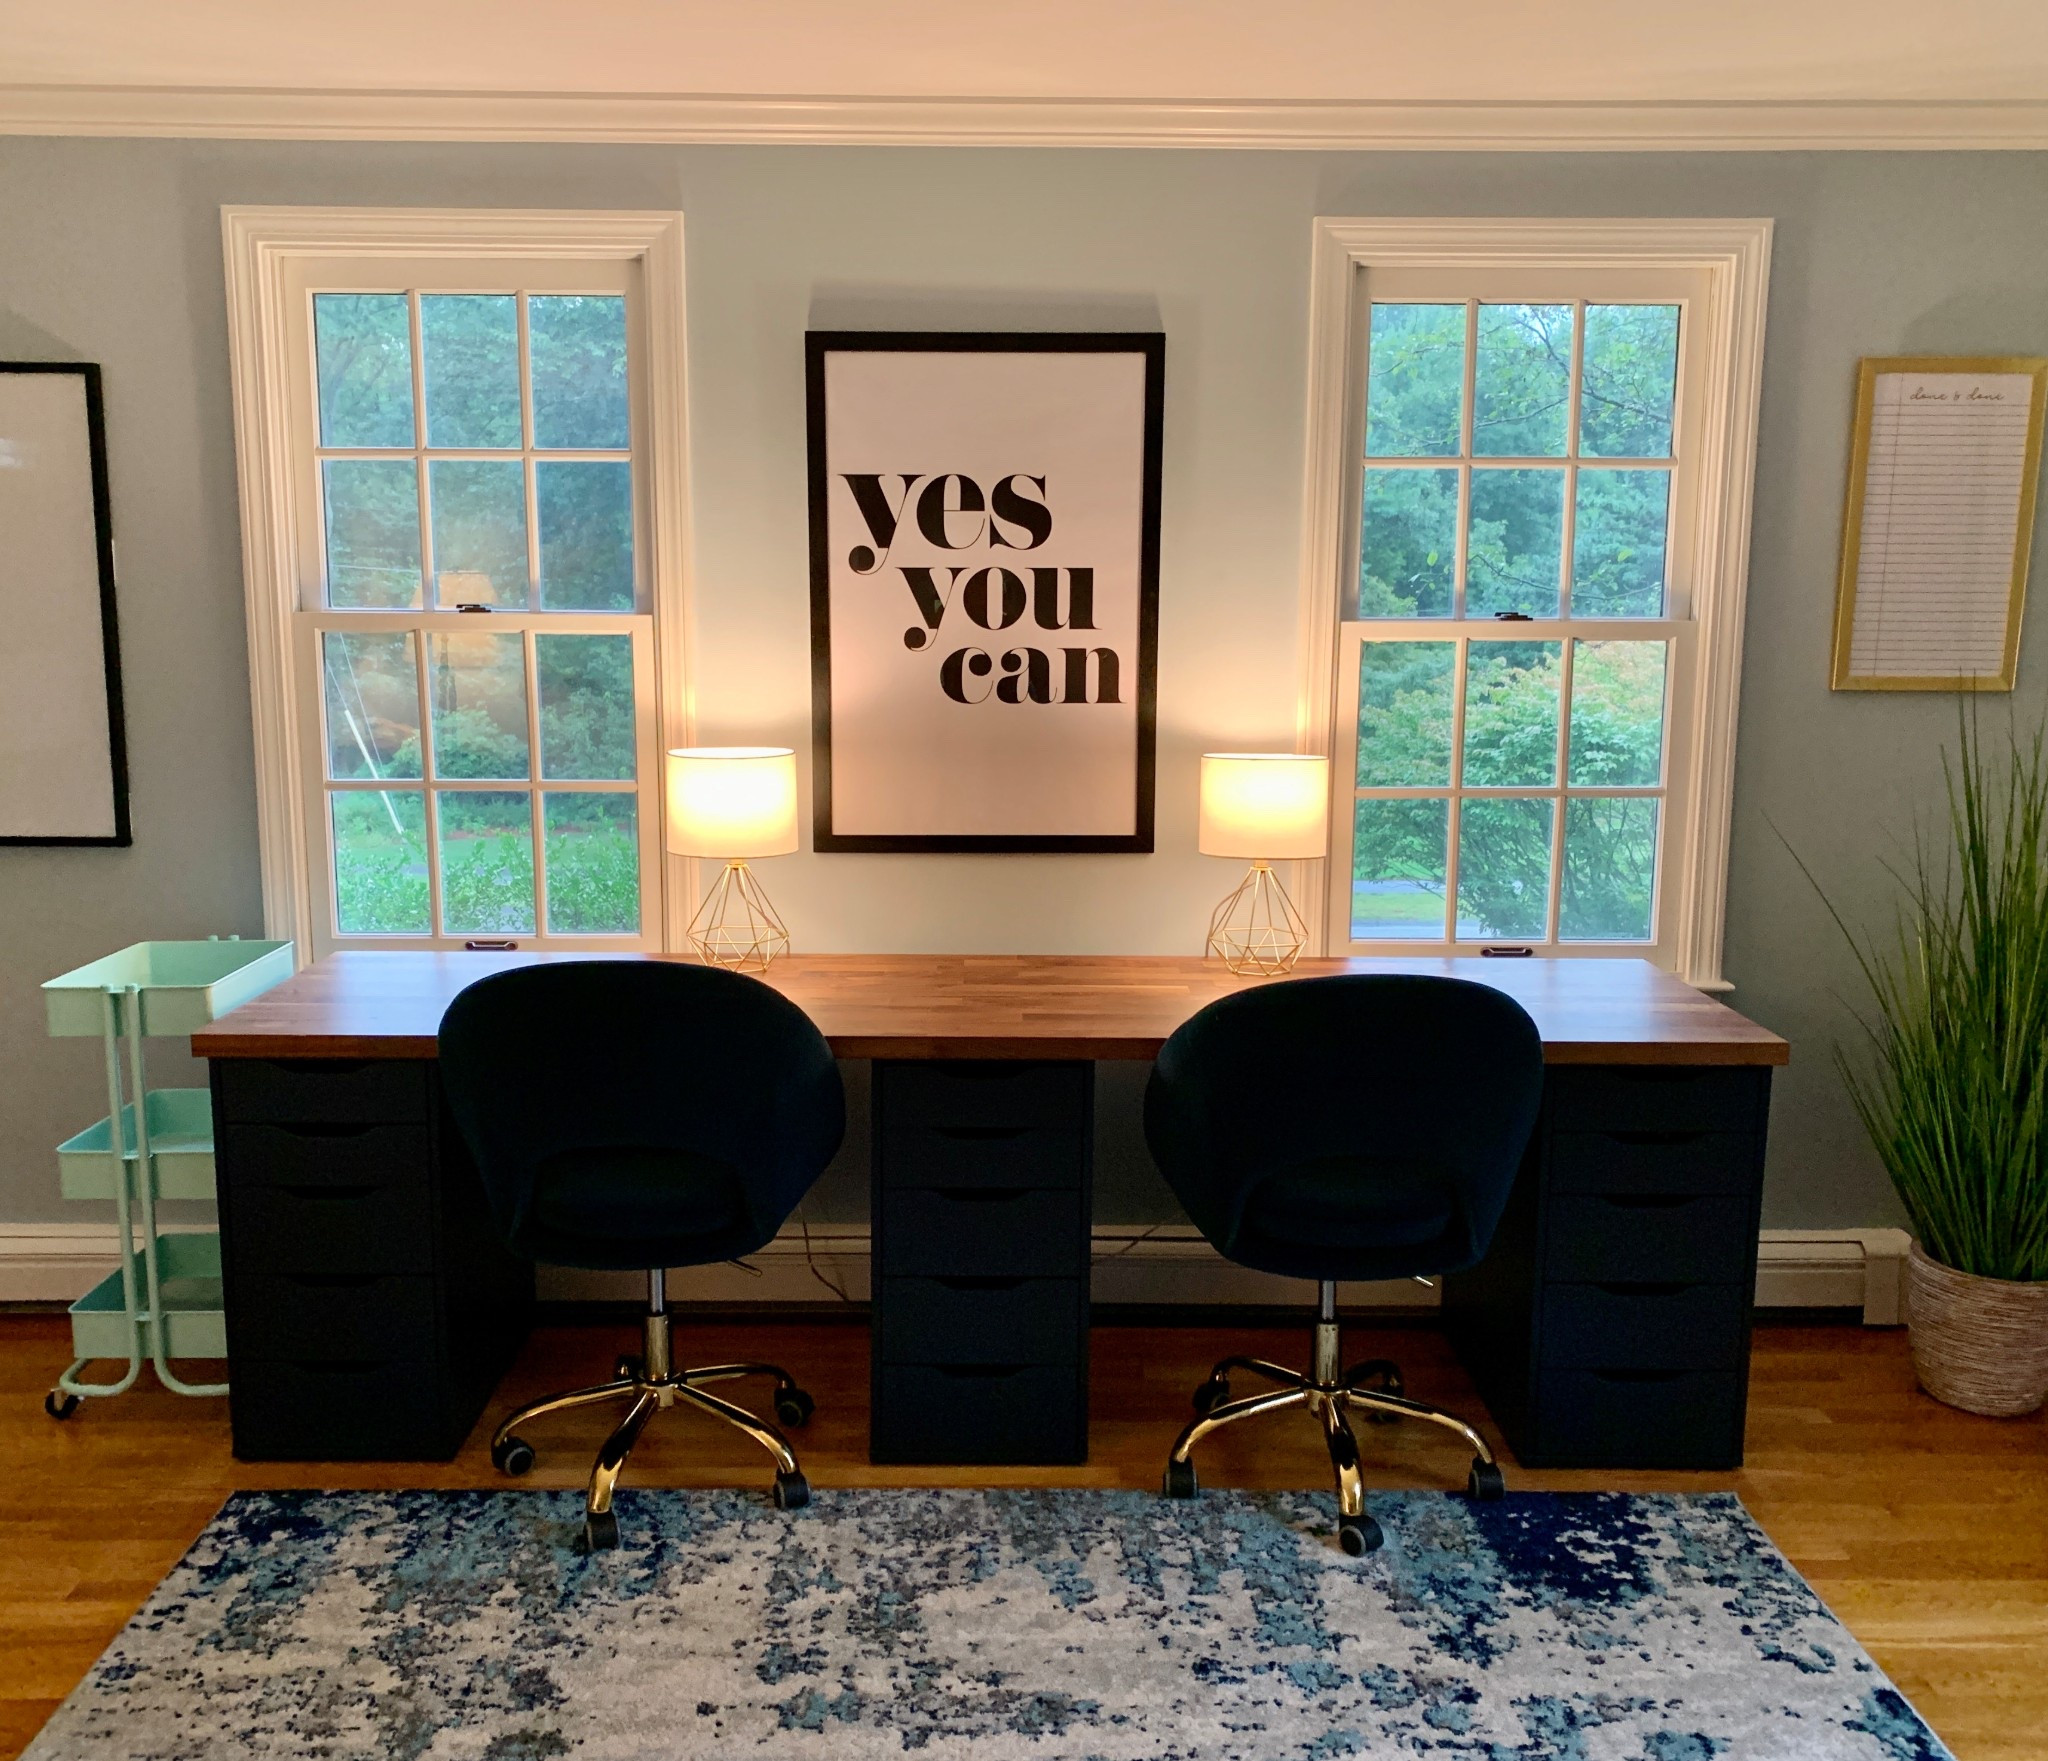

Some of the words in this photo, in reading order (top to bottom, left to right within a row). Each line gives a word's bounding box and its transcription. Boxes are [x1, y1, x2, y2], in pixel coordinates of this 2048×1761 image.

[1910, 386, 1948, 401] done
[1967, 387, 2006, 401] done
[837, 473, 1053, 576] yes
[895, 566, 1103, 652] you
[939, 646, 1128, 705] can
